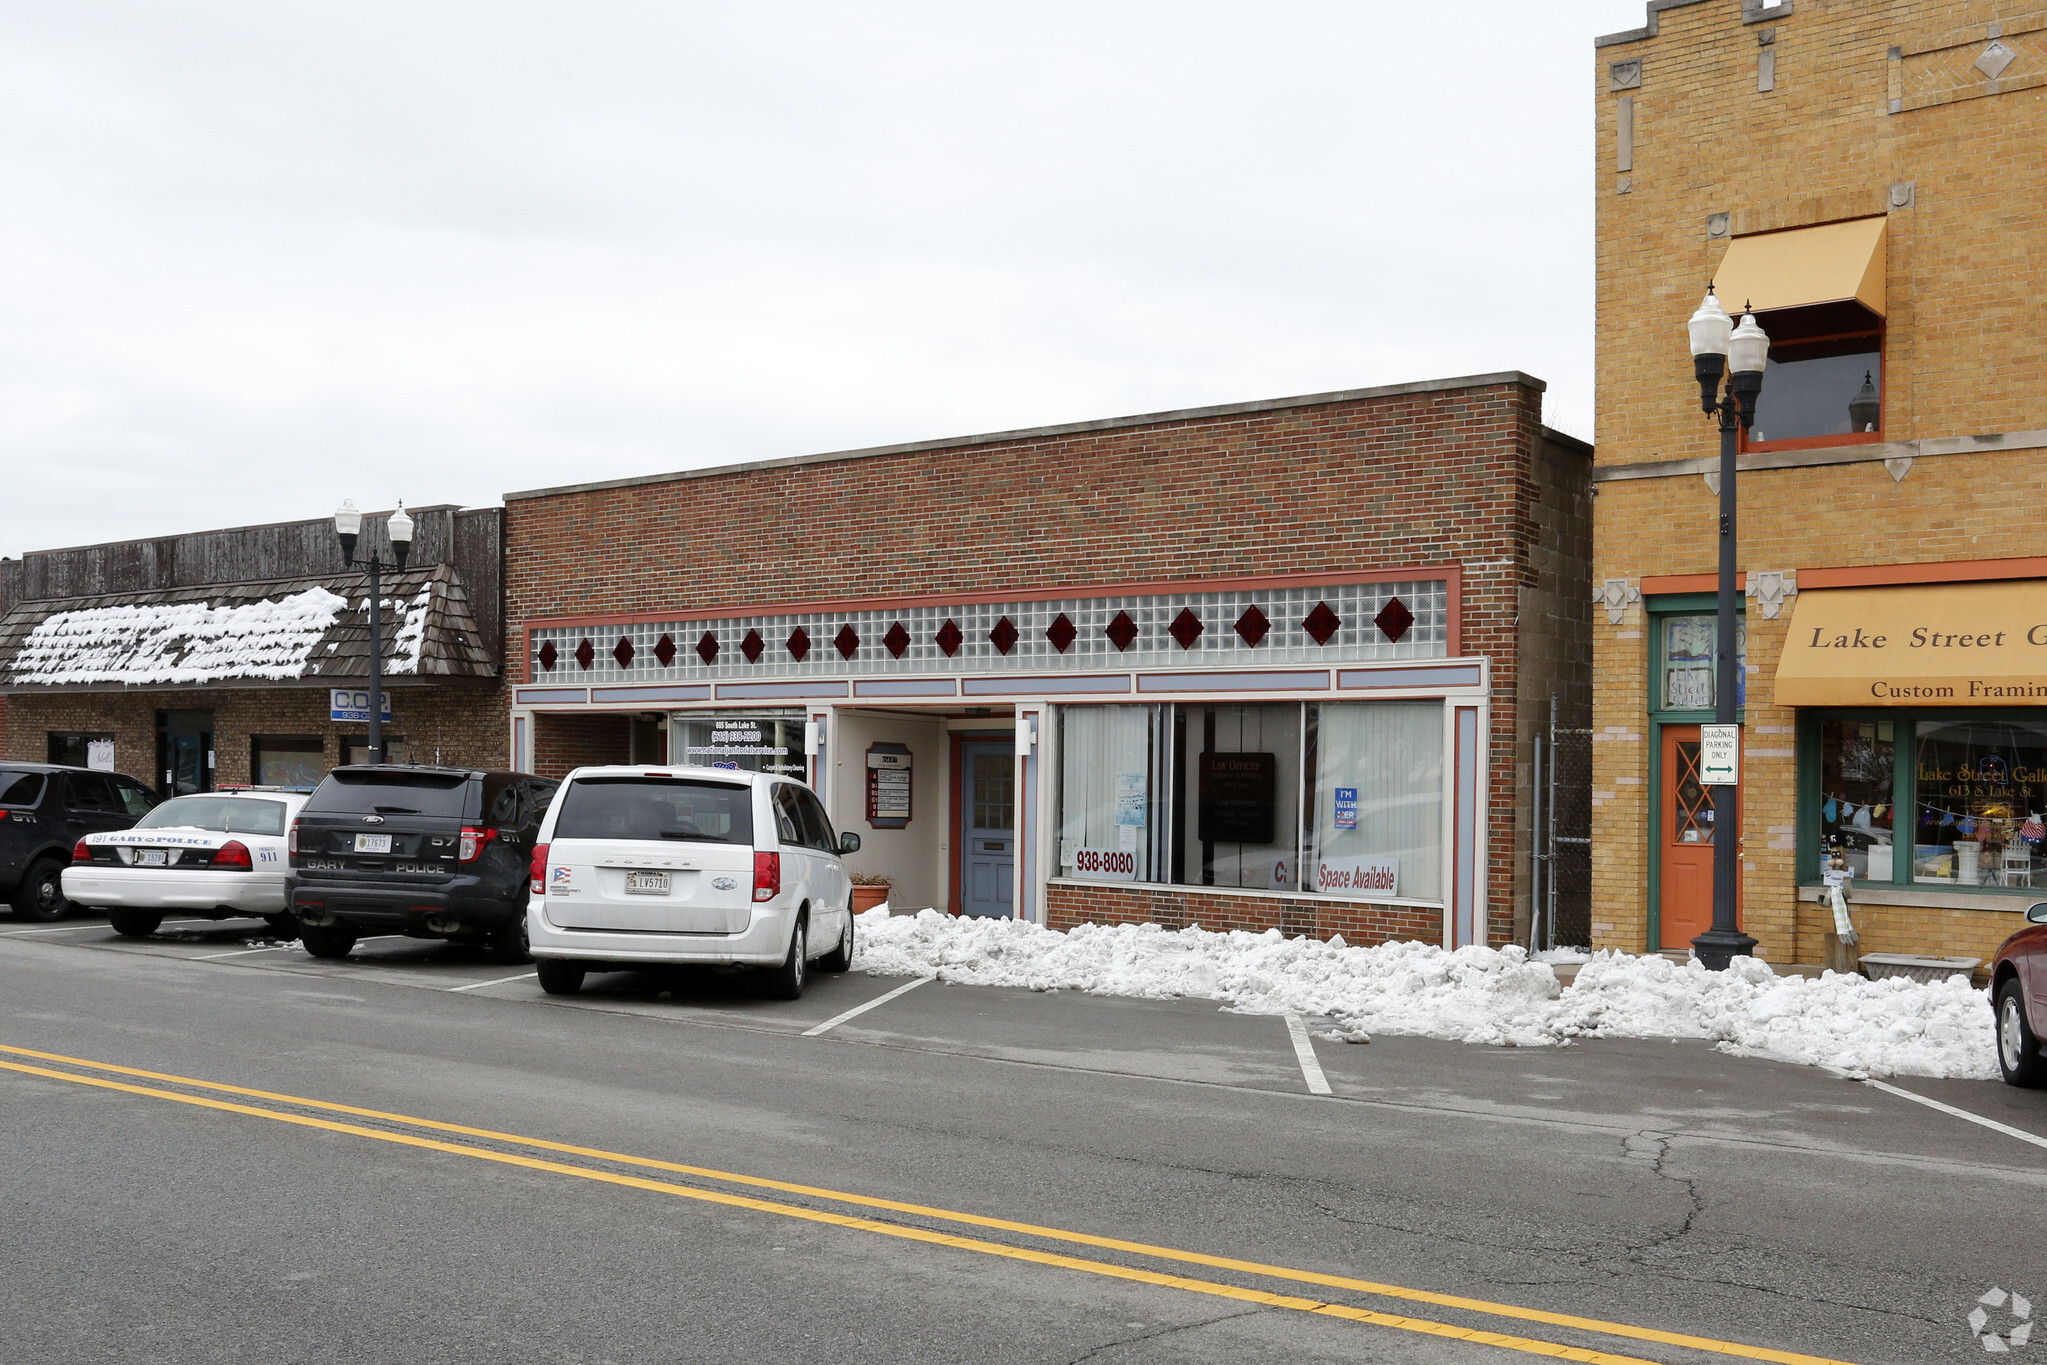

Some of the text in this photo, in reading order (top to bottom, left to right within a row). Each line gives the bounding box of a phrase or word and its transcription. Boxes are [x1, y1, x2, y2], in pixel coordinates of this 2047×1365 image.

[1808, 627, 1887, 648] Lake
[1909, 627, 2006, 648] Street
[1871, 681, 1954, 698] Custom
[342, 711, 370, 719] 938-0
[725, 721, 738, 729] South
[738, 721, 749, 729] Lake
[1704, 730, 1735, 739] DIAGONAL
[1711, 751, 1728, 759] ONLY
[1918, 762, 1951, 781] Lake
[1957, 763, 2006, 781] Street
[1340, 790, 1352, 798] I'M
[1948, 785, 1970, 796] 613
[1990, 785, 2015, 797] Lake
[2020, 786, 2036, 798] St.
[1335, 801, 1357, 809] WITH
[92, 834, 107, 843] 191
[156, 836, 213, 846] POLICE
[367, 839, 386, 847] 17673
[431, 836, 455, 846] 57
[148, 853, 163, 862] 1528
[260, 851, 277, 862] 911
[1076, 850, 1134, 874] 938-8080
[307, 860, 445, 874] GARY POLICE
[639, 877, 668, 888] LV5710
[1318, 863, 1350, 891] Space
[1352, 865, 1395, 891] Available
